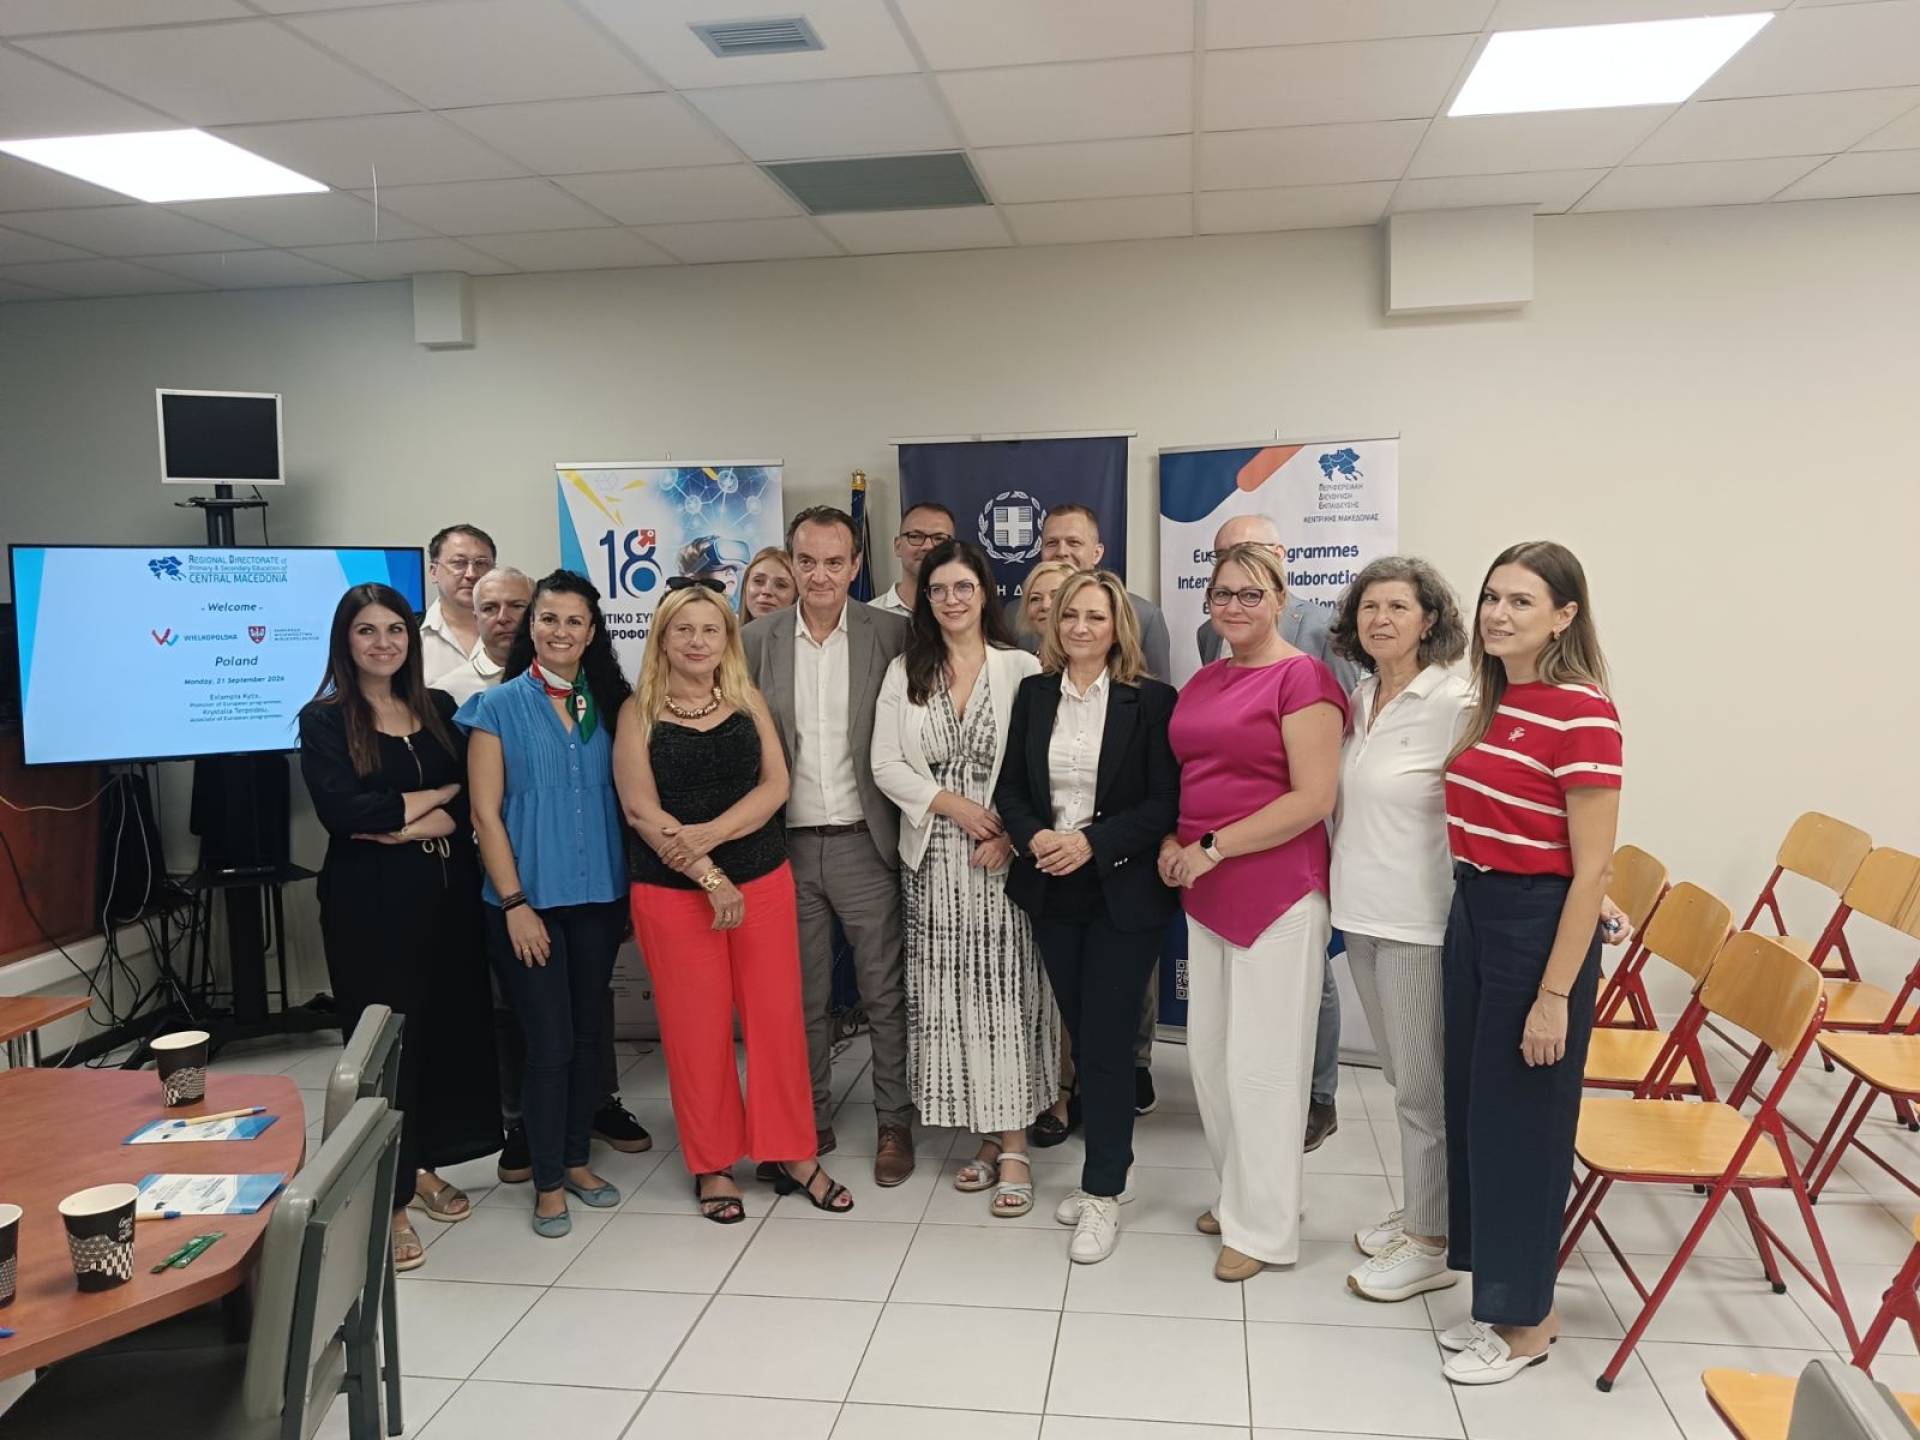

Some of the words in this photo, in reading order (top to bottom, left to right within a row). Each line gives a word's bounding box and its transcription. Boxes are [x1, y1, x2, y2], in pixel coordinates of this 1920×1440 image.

[1287, 545, 1359, 563] grammes
[189, 574, 231, 583] CENTRAL
[234, 573, 287, 583] MACEDONIA
[208, 602, 257, 612] Welcome
[215, 656, 259, 667] Poland
